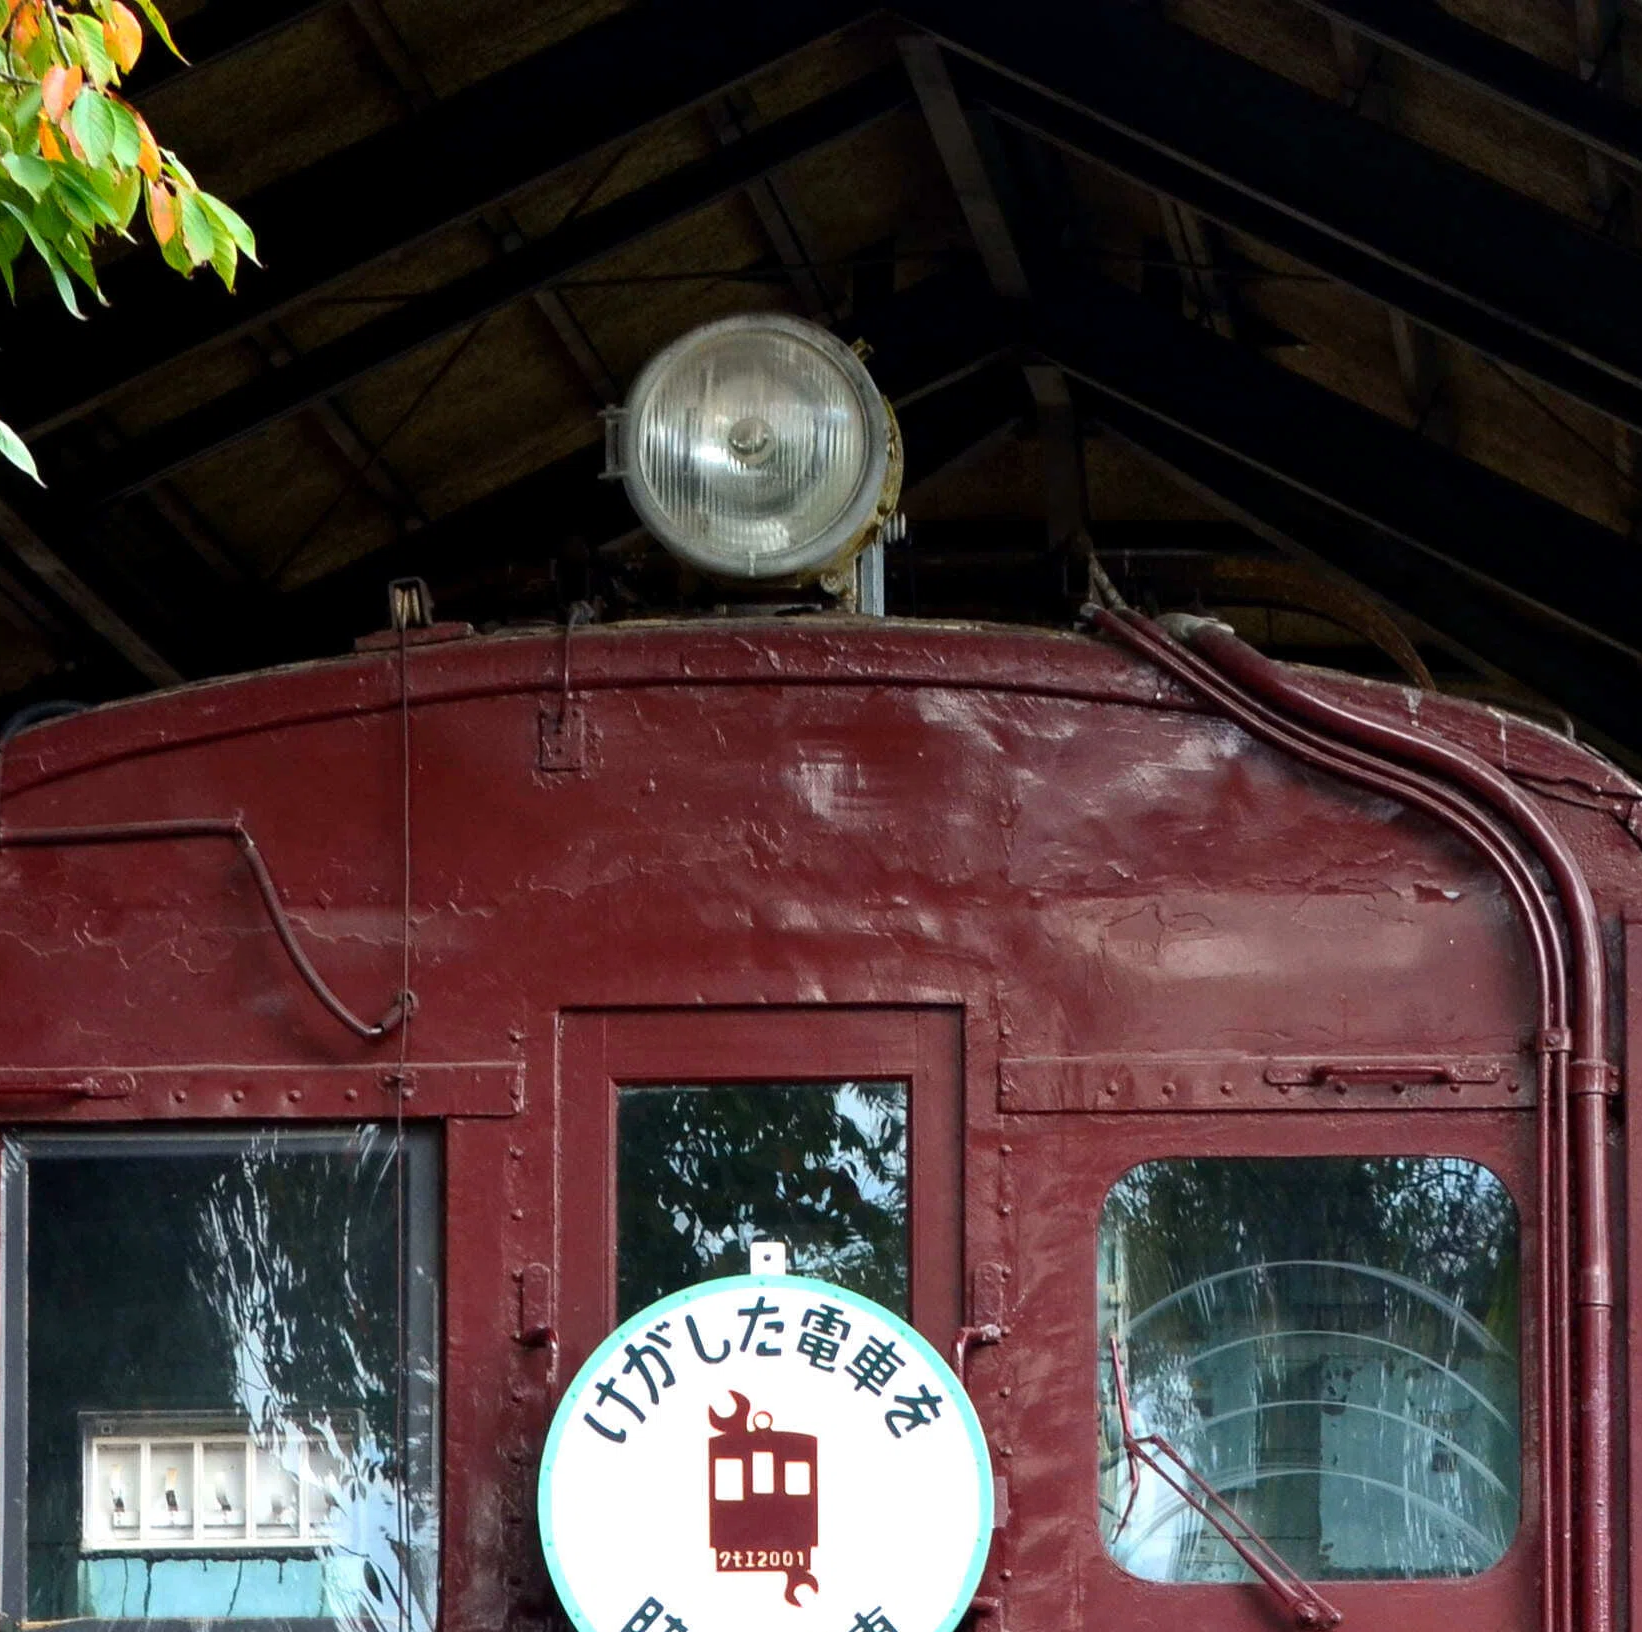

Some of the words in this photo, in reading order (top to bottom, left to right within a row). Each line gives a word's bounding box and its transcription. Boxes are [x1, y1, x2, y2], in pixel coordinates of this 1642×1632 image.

[584, 1297, 944, 1444] けがした電車を
